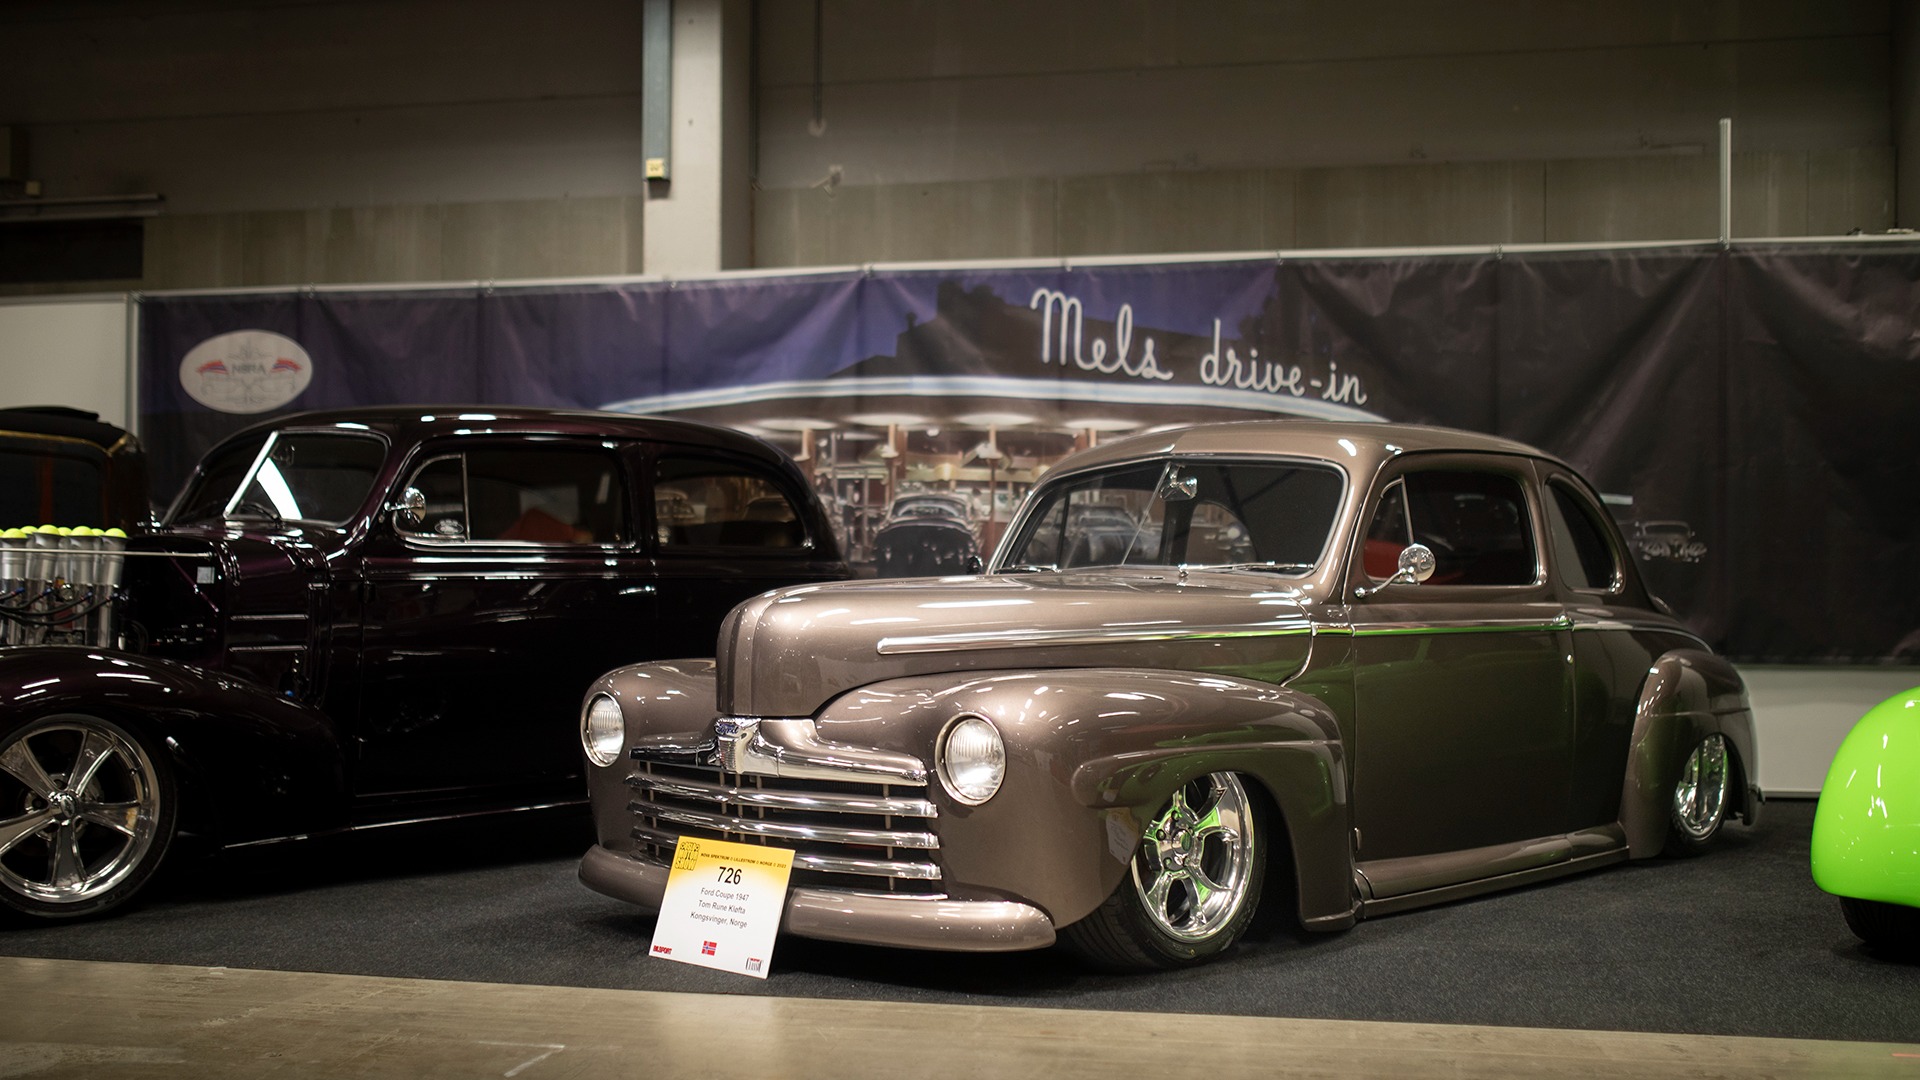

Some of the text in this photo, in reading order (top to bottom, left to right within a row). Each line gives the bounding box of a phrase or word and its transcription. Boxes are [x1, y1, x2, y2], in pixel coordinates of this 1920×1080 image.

[1029, 287, 1368, 406] Mels drive-in
[718, 866, 742, 885] 726
[700, 887, 749, 901] Ford Coupe 1947
[698, 899, 711, 908] Tom
[711, 902, 728, 912] Rune
[690, 911, 748, 930] Kongsvinger, Norge
